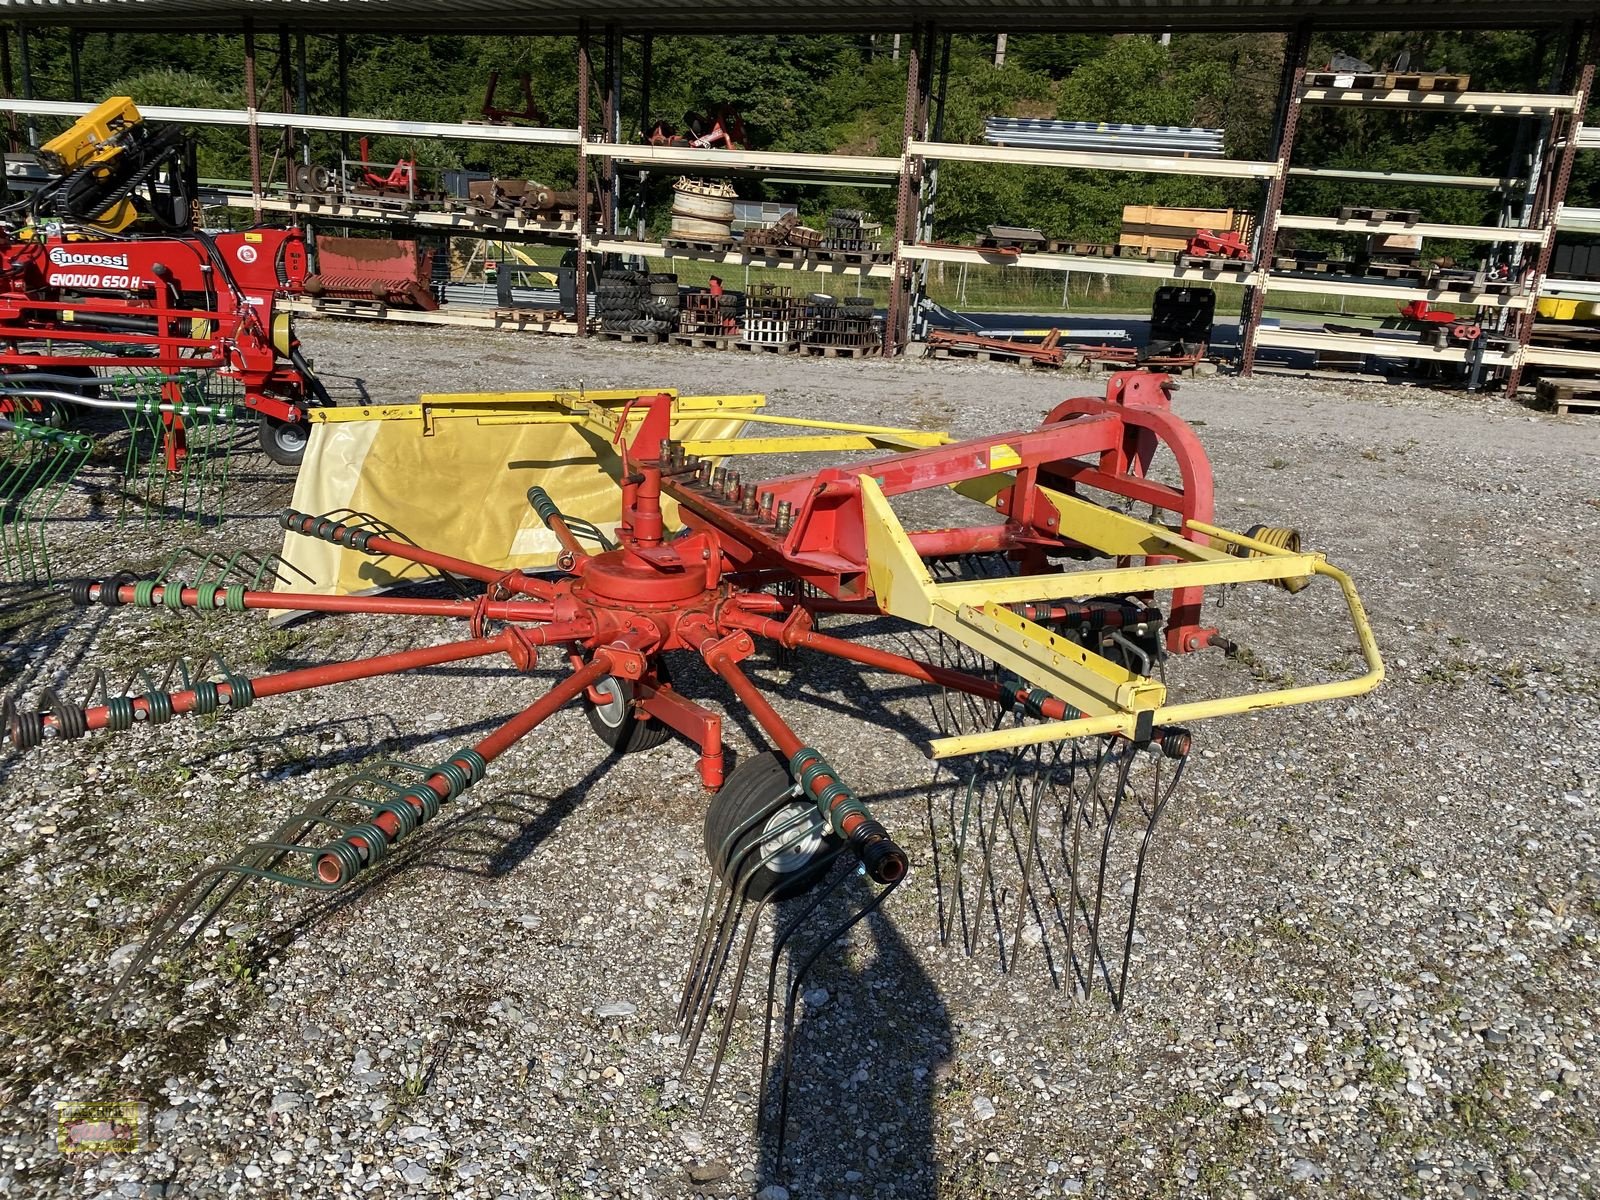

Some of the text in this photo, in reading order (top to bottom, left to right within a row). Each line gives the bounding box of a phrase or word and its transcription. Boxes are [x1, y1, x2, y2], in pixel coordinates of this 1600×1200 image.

[50, 249, 128, 267] enorossi
[50, 274, 140, 288] ENODUO 650 H
